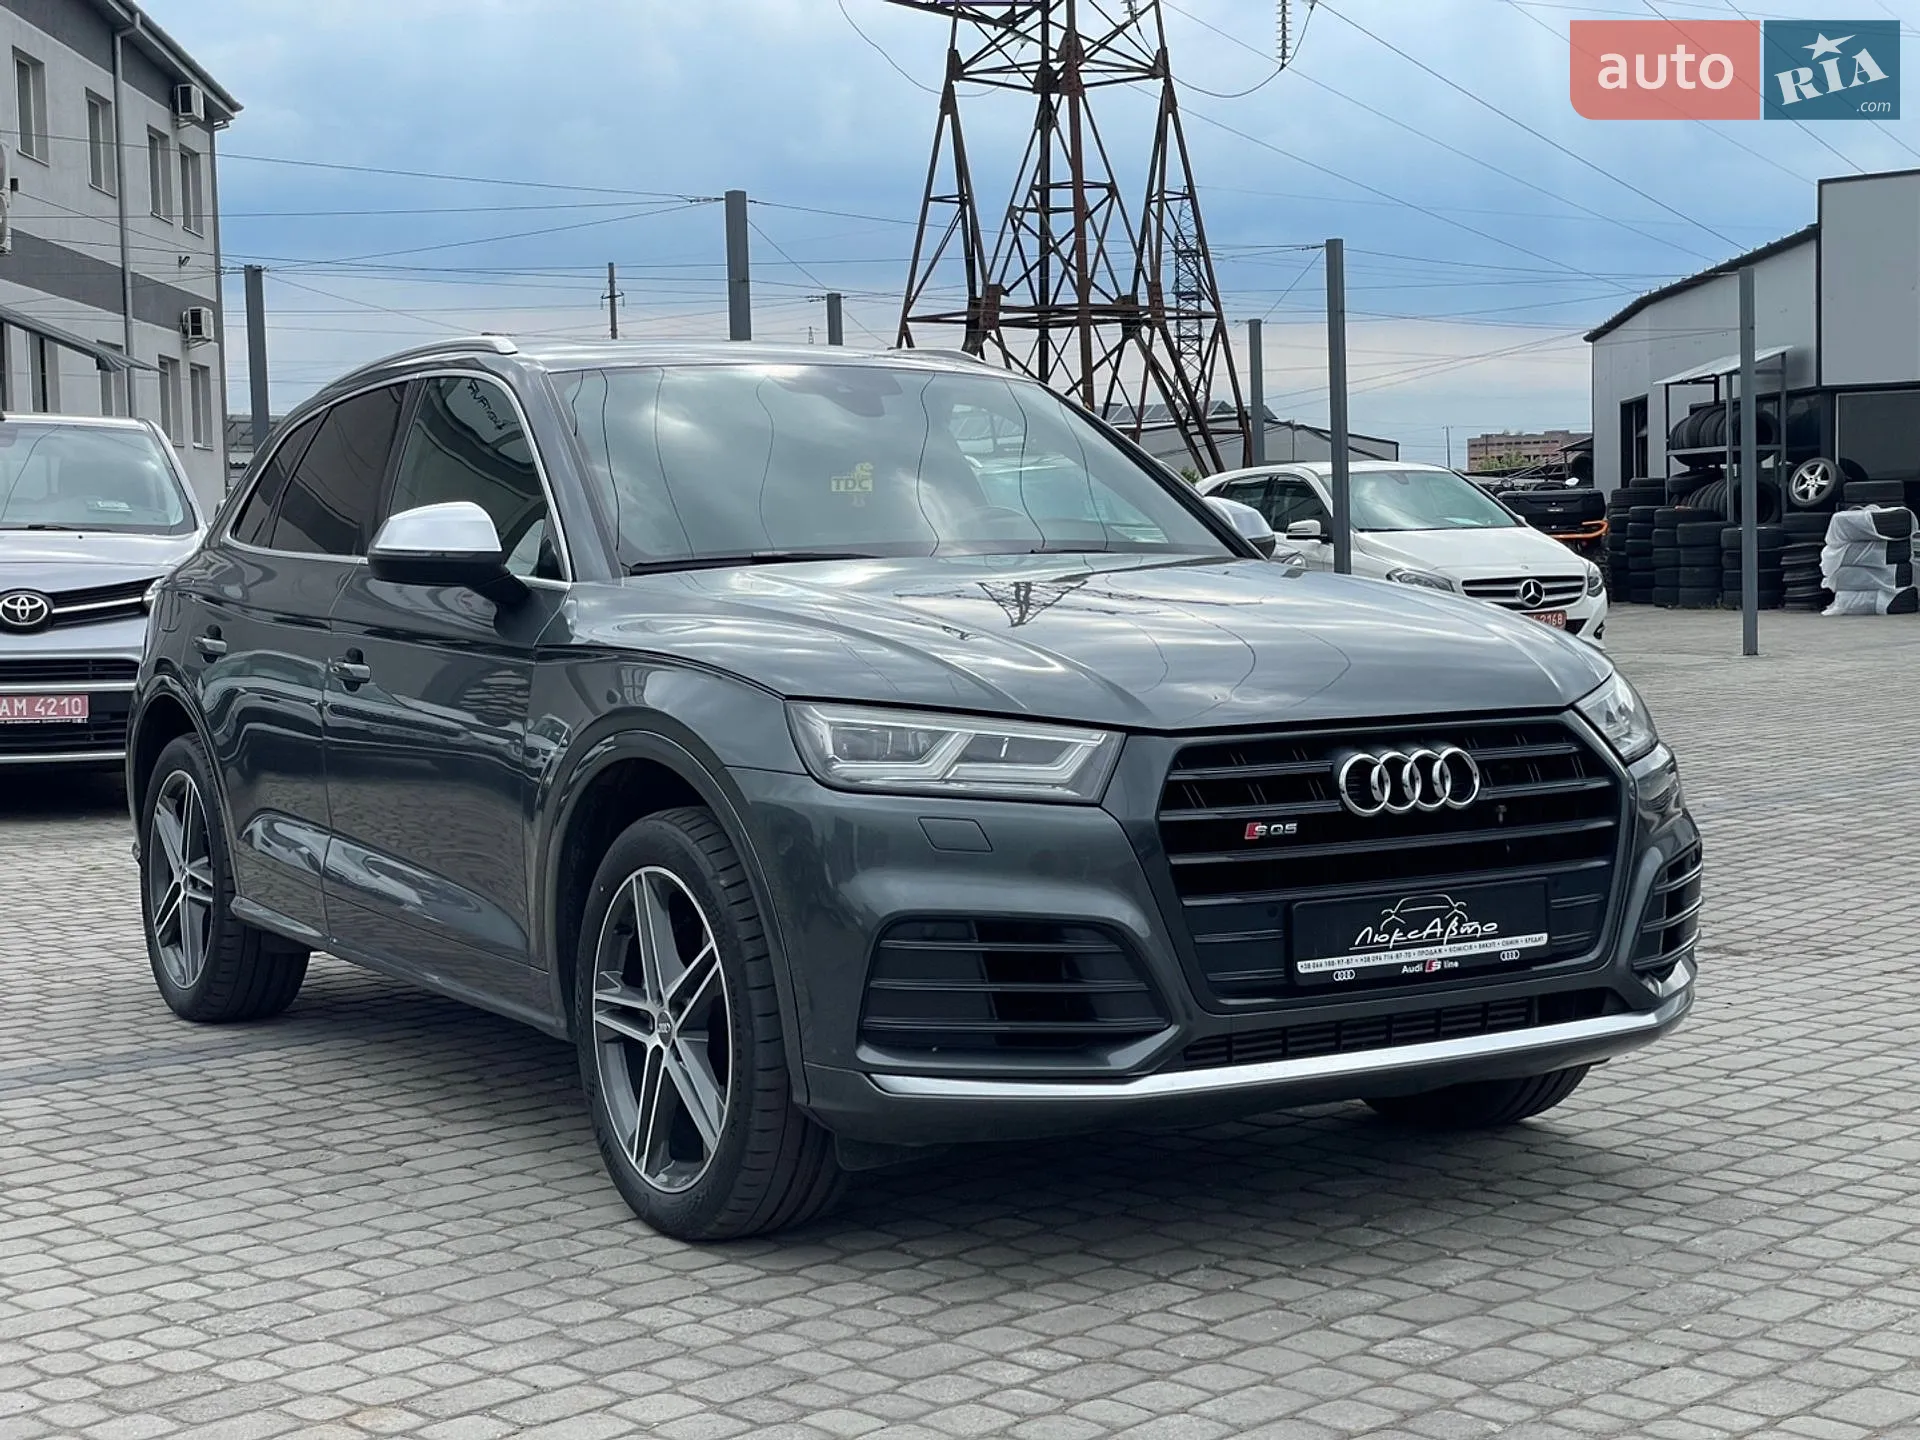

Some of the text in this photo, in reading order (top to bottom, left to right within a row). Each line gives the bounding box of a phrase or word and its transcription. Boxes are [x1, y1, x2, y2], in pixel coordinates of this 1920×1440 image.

[34, 697, 82, 716] 4210
[1247, 822, 1298, 838] SQ5
[1401, 963, 1424, 974] Audi
